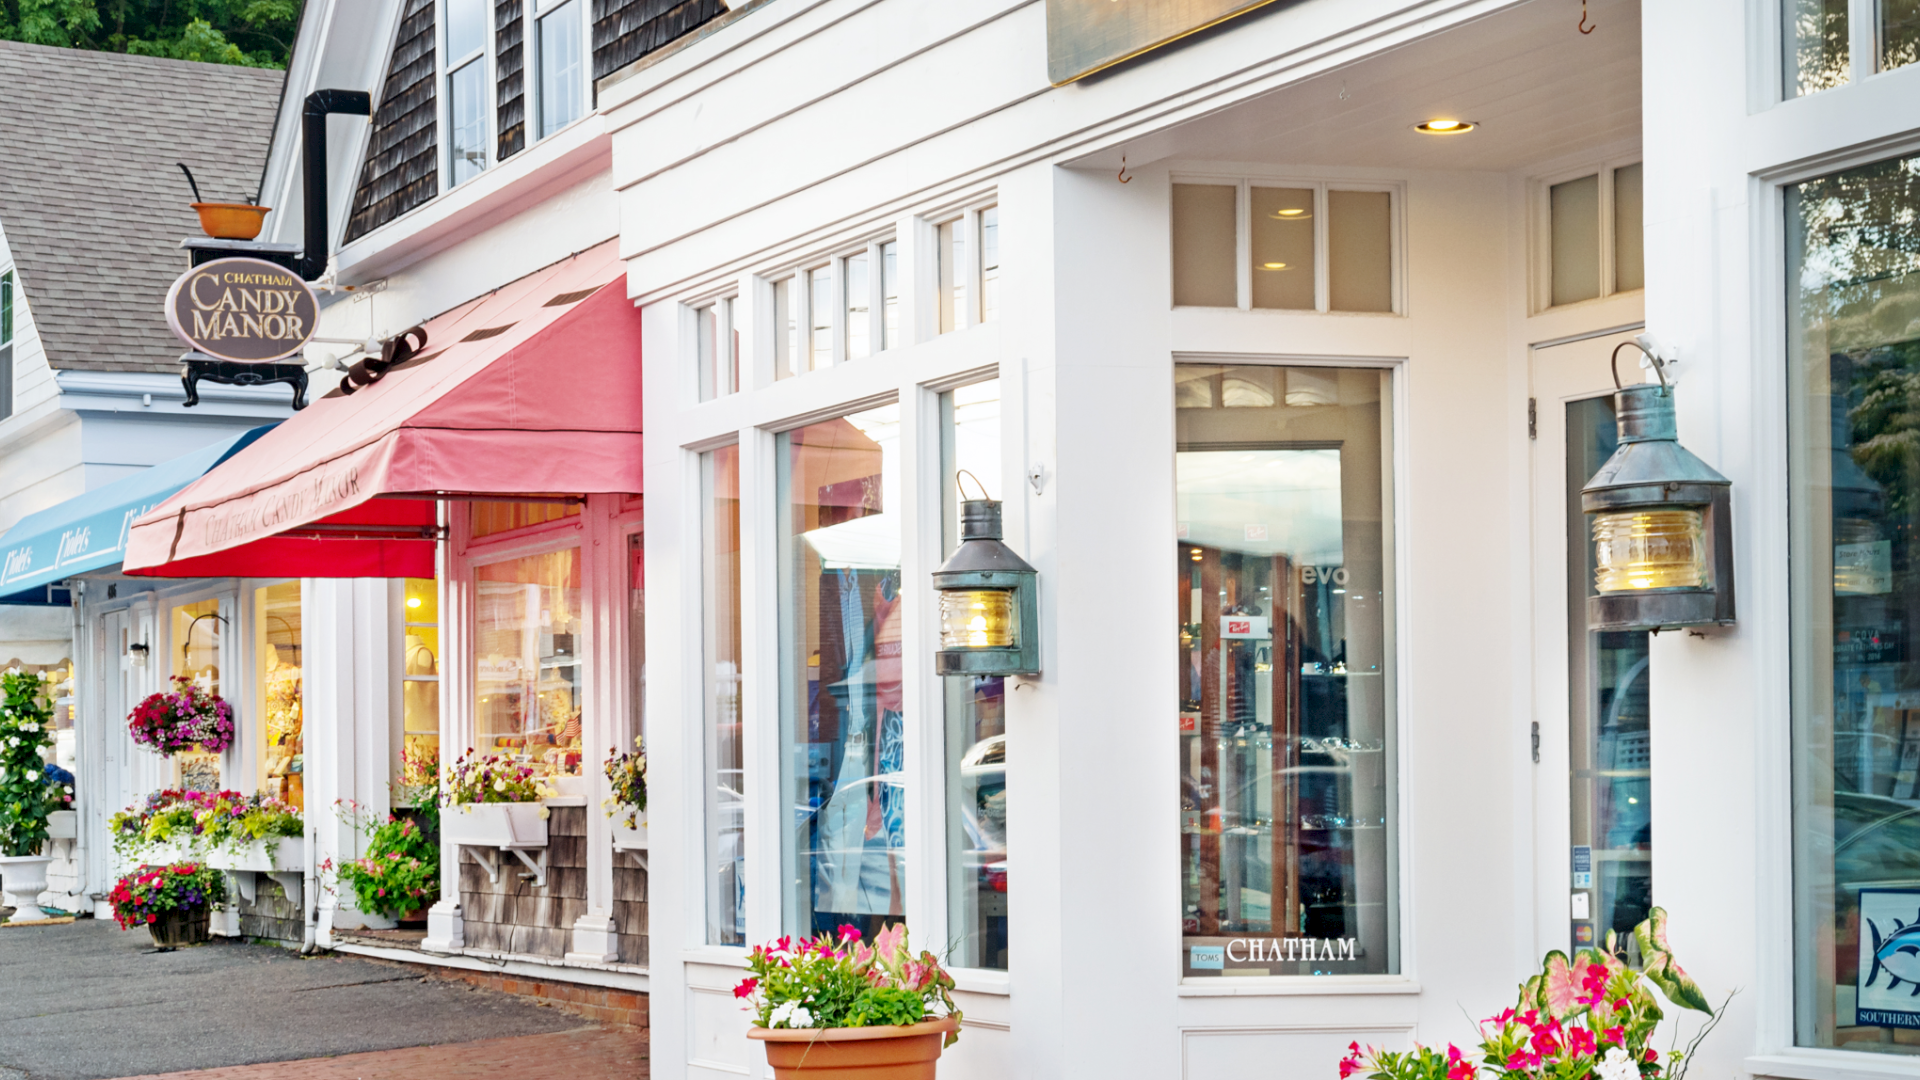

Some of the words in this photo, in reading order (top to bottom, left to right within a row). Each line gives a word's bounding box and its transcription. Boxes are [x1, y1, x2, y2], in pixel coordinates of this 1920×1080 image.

[224, 272, 292, 286] CHATHAM
[190, 272, 302, 314] CANDY
[190, 309, 304, 340] MANOR
[205, 507, 260, 546] CHATHAM
[262, 488, 309, 528] CANDY
[308, 466, 360, 512] MANOR
[1302, 566, 1350, 585] evo
[1196, 954, 1220, 962] TOMS
[1226, 938, 1356, 962] CHATHAM
[1860, 1010, 1920, 1026] SOUTHERN
